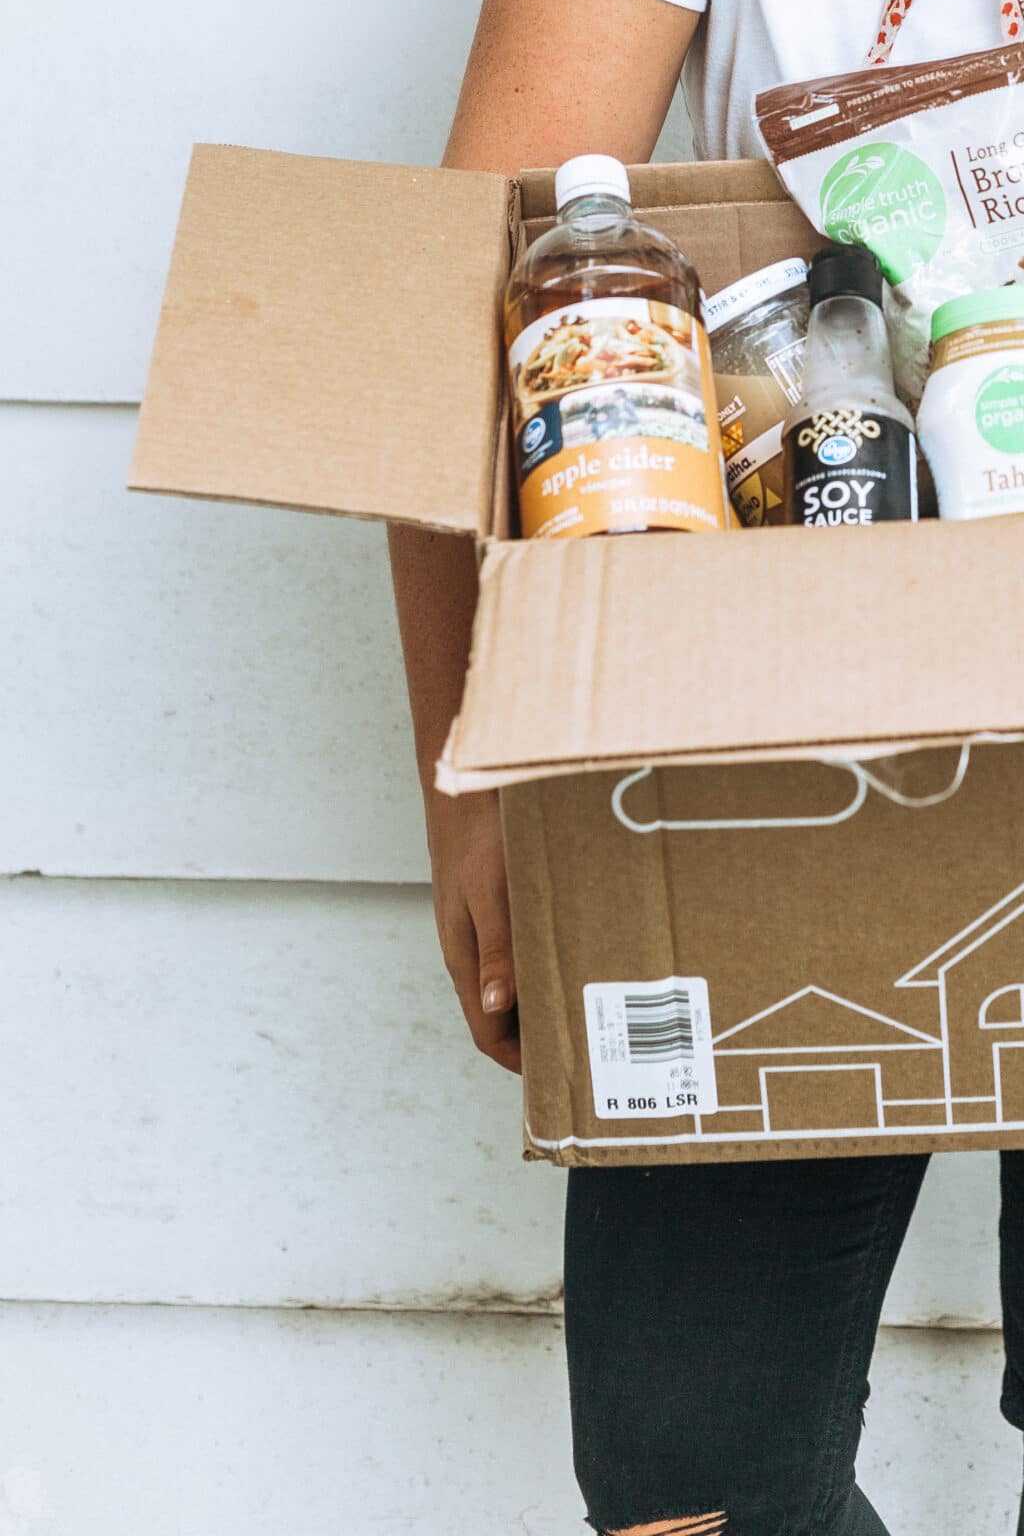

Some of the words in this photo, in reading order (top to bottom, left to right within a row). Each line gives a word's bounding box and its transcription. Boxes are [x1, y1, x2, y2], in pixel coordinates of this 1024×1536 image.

[846, 92, 872, 108] PRESS
[872, 84, 900, 100] ZIPPER
[901, 79, 914, 91] TO
[914, 71, 947, 88] RESEAL
[965, 142, 1009, 163] Long
[828, 194, 876, 227] simple
[877, 178, 930, 208] truth
[836, 199, 938, 246] organic
[979, 394, 1018, 411] simple
[541, 454, 600, 496] apple
[608, 445, 675, 472] cider
[803, 480, 875, 516] SOY
[803, 508, 873, 528] SAUCE
[607, 1098, 619, 1110] R
[627, 1097, 657, 1110] 806
[666, 1093, 698, 1108] LSR
